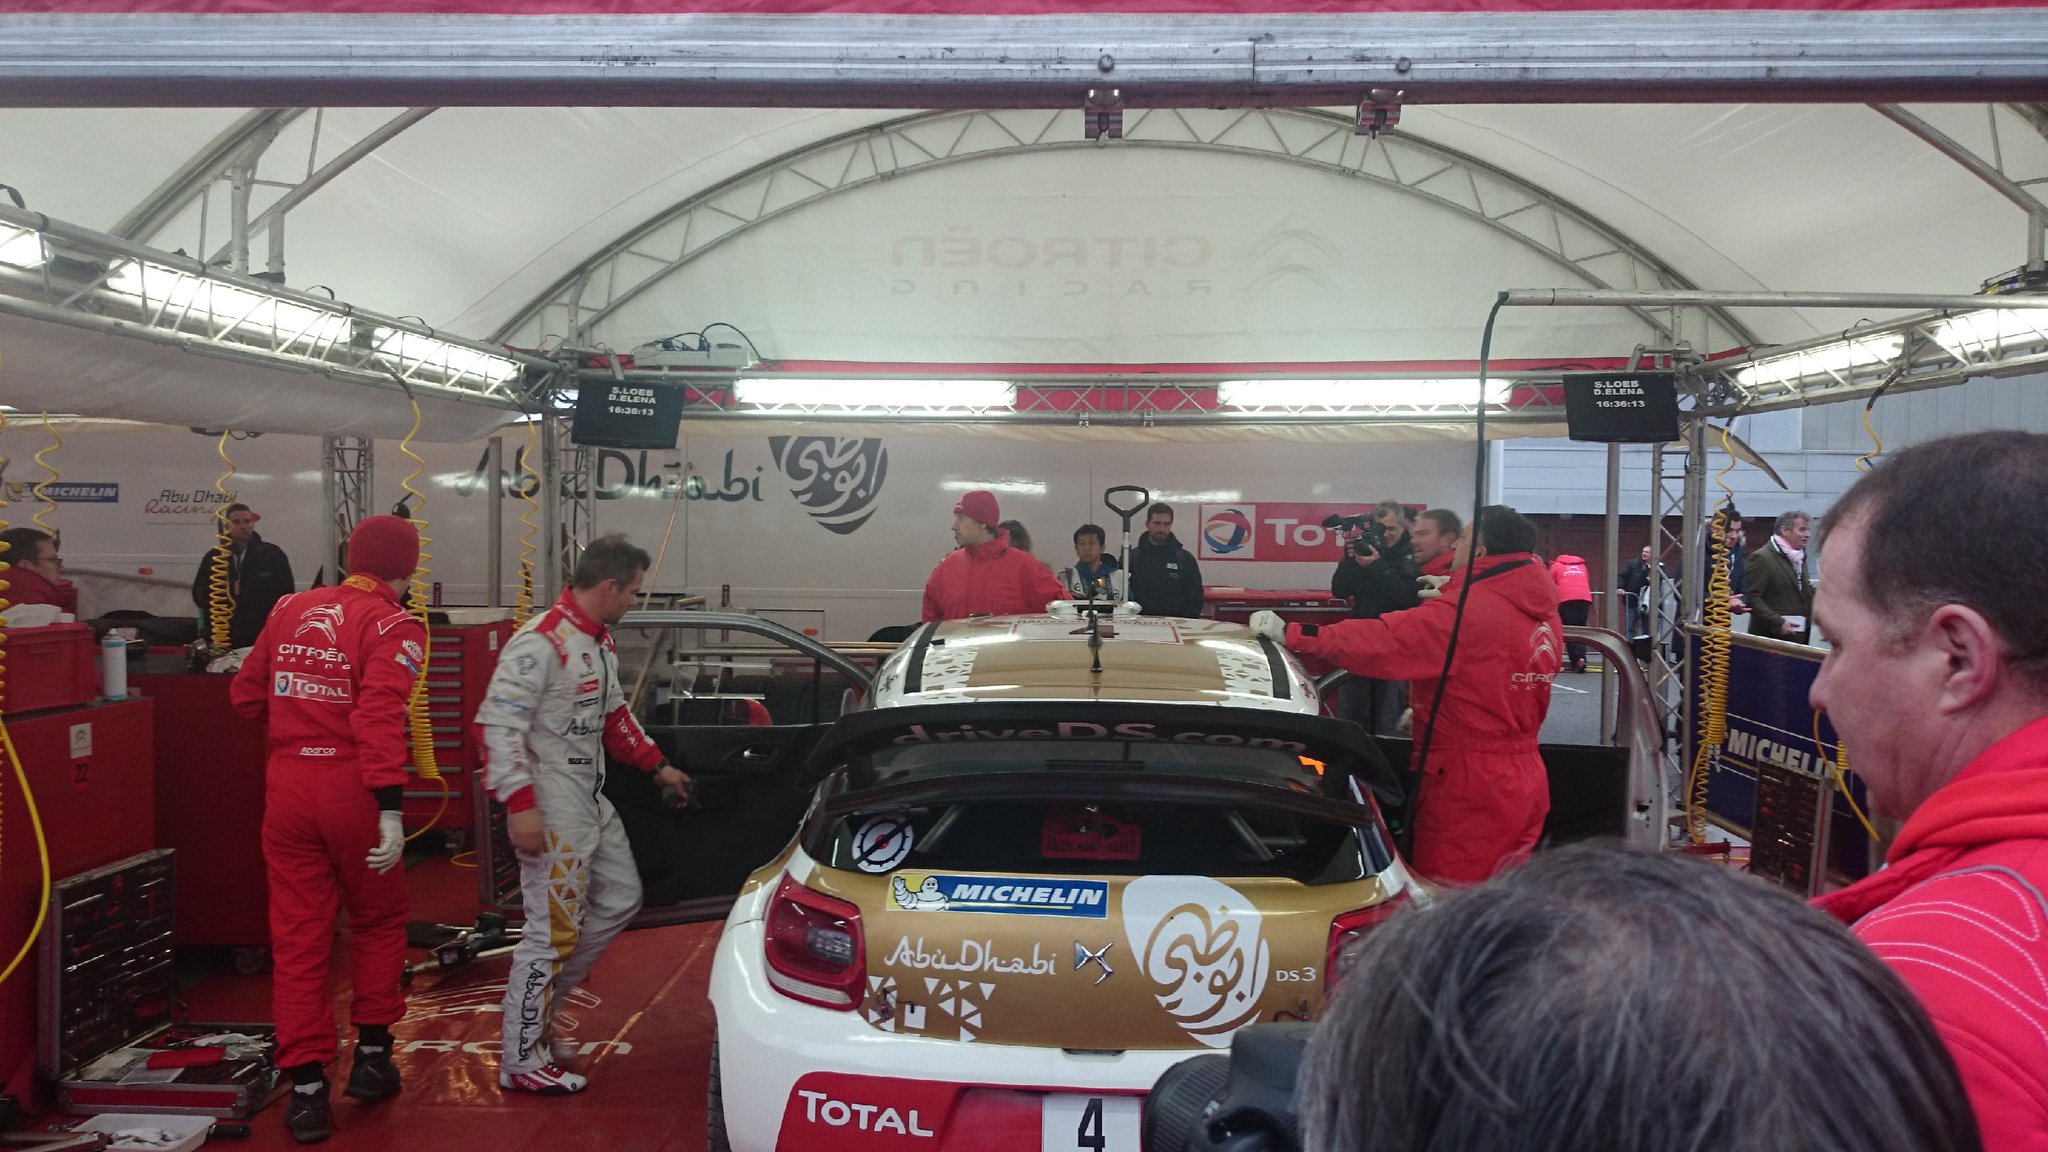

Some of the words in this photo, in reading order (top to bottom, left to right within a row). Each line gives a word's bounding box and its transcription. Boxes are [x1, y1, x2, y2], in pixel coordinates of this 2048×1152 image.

[611, 386, 654, 397] S.LOEB
[1594, 380, 1639, 389] S.LOEB
[608, 394, 657, 404] D.ELENA
[1593, 388, 1645, 396] D.ELENA
[608, 406, 654, 416] 16:36:13
[1596, 400, 1646, 408] 16:36:13
[160, 489, 190, 503] Abu
[1264, 518, 1346, 547] TOT
[294, 678, 349, 697] TOTAL
[893, 721, 1307, 753] driveDS.com
[951, 884, 1104, 906] MICHELIN
[798, 1089, 934, 1137] TOTAL
[1077, 1097, 1106, 1151] 4
